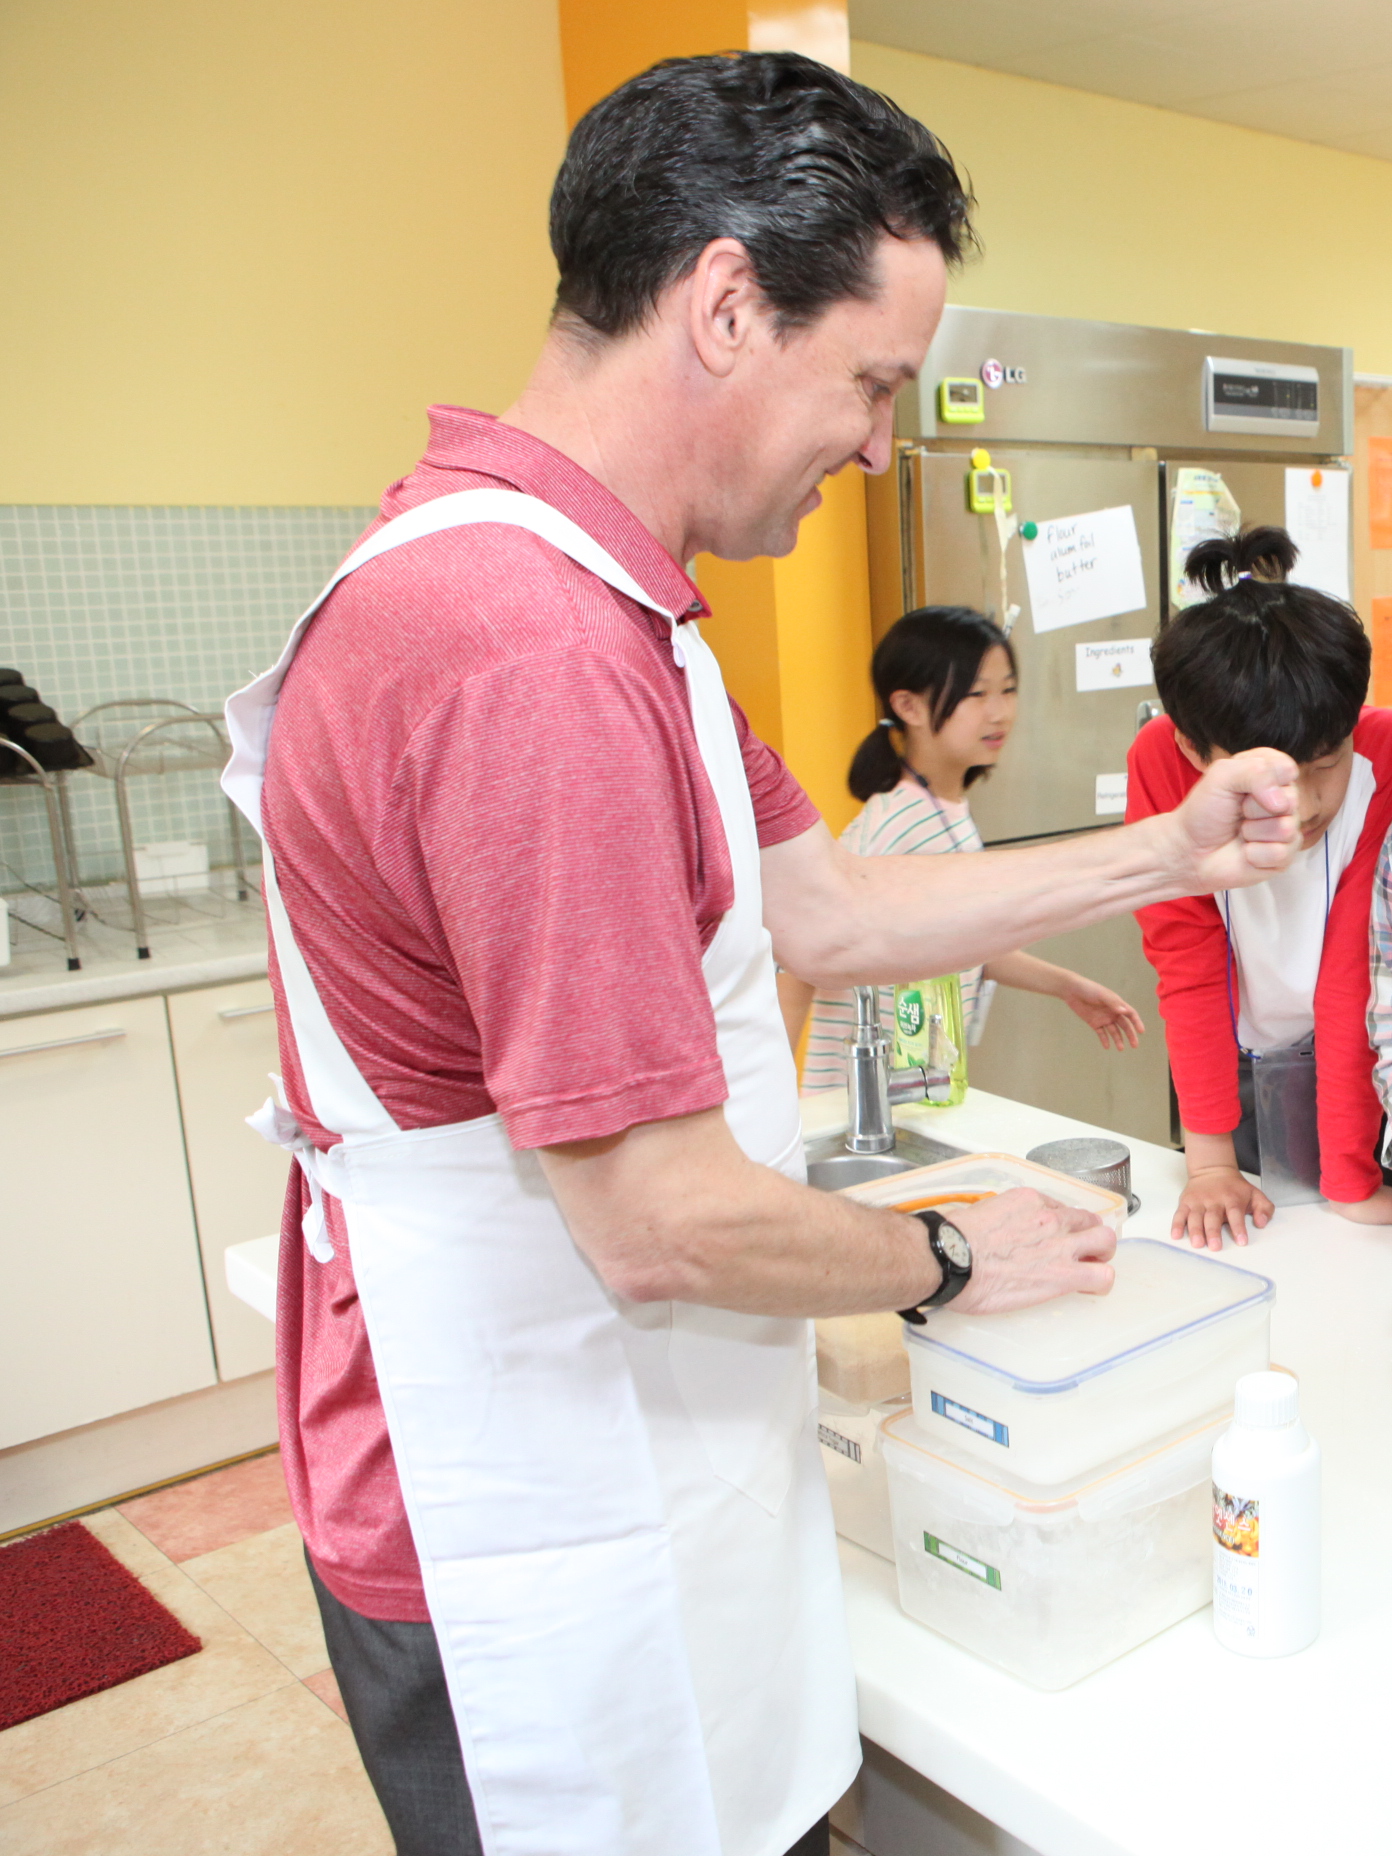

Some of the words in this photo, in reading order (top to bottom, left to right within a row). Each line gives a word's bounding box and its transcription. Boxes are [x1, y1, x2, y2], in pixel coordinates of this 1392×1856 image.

[1056, 557, 1097, 583] butter
[1085, 645, 1135, 660] Ingredients
[897, 997, 920, 1025] 순샘
